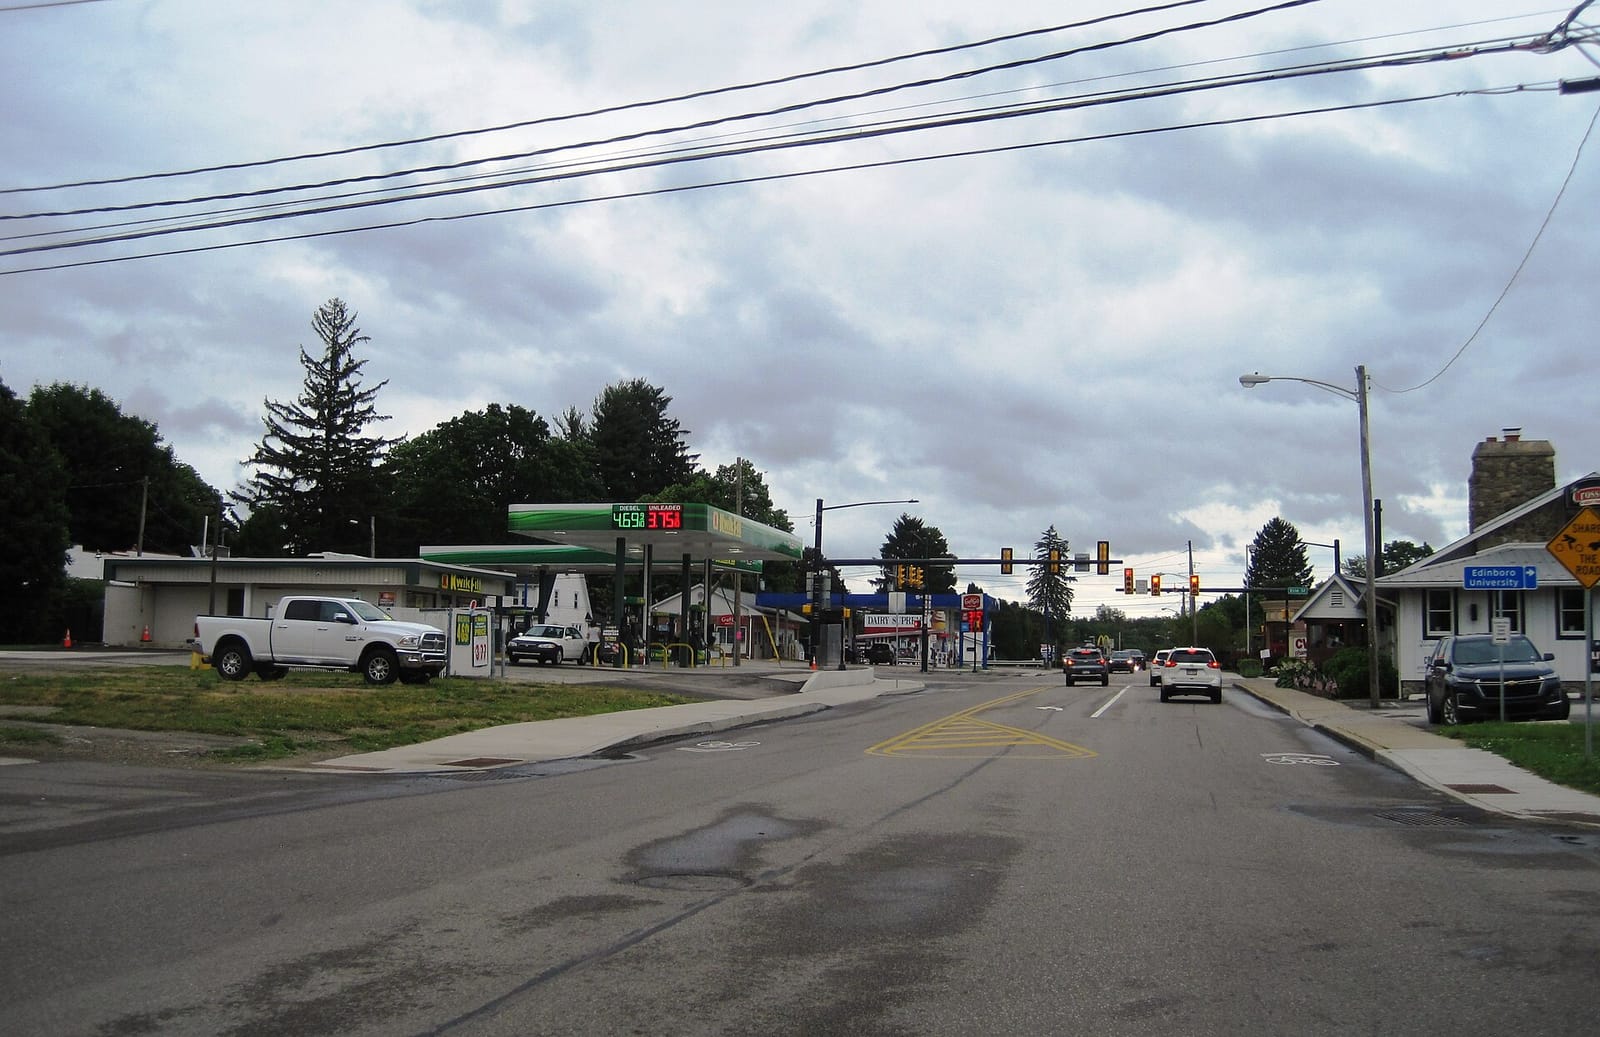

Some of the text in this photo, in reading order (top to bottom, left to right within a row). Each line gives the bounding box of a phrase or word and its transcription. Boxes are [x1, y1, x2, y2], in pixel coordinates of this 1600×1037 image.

[1579, 553, 1598, 564] THE
[1471, 569, 1517, 577] Edinboro
[1470, 579, 1518, 588] University
[868, 616, 889, 625] DAIRY
